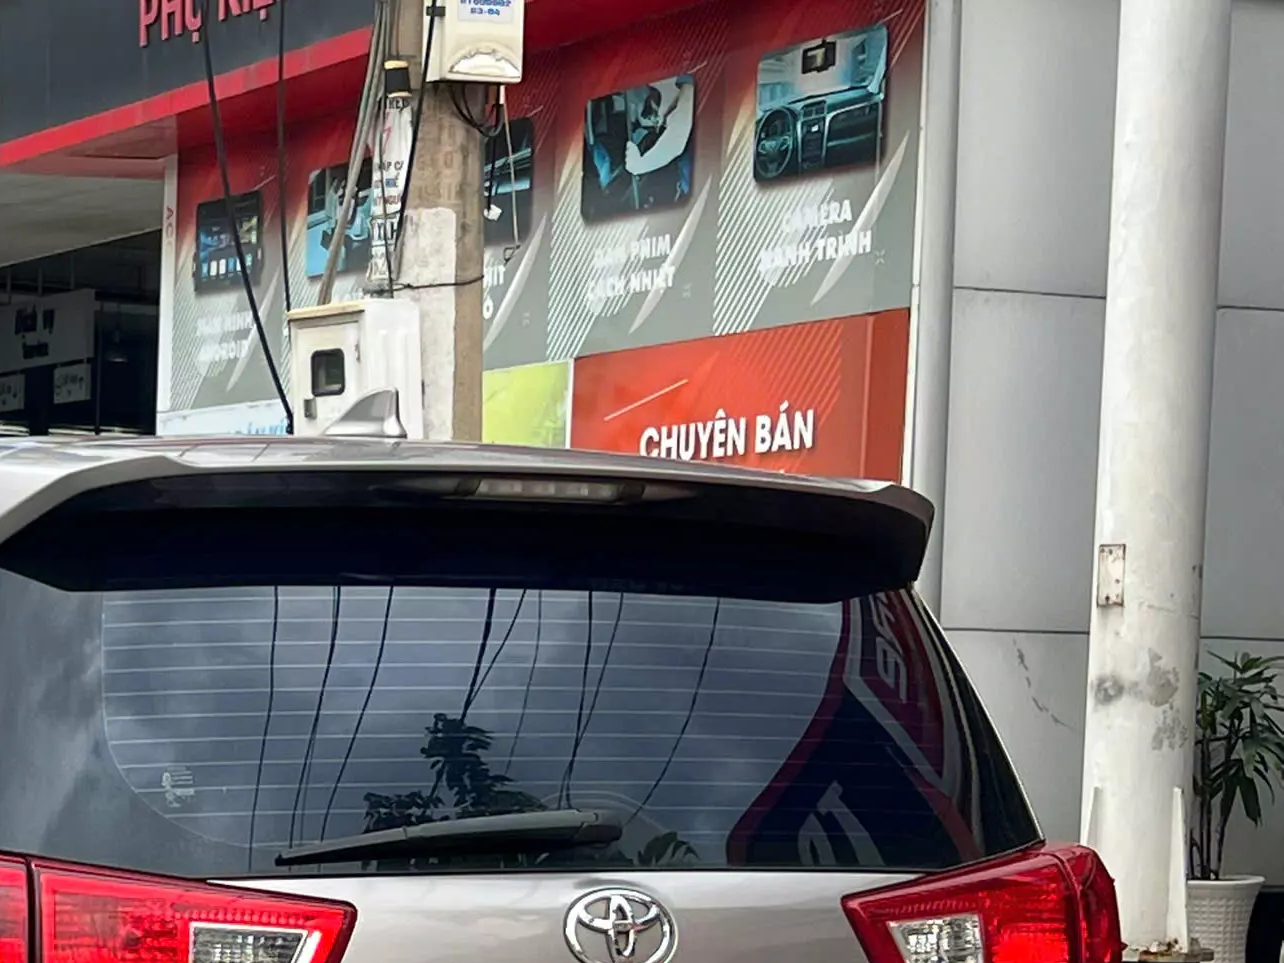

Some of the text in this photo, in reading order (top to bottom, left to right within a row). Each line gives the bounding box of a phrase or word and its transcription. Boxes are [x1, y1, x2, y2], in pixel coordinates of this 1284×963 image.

[780, 199, 853, 232] CAMERA
[639, 399, 814, 461] CHUYÊN BÁN
